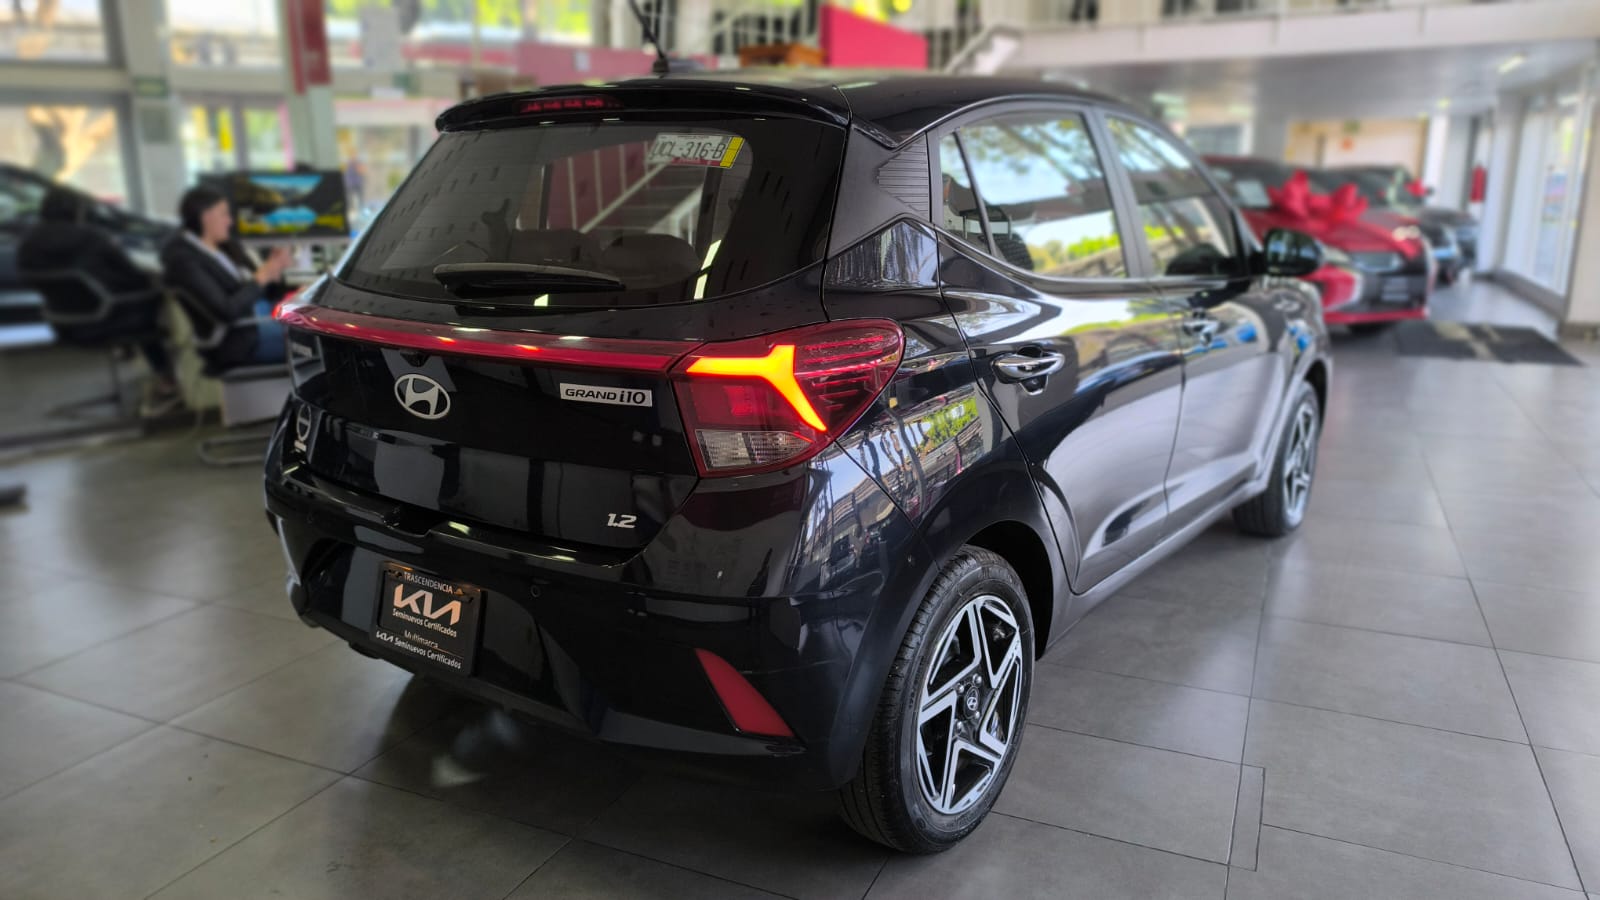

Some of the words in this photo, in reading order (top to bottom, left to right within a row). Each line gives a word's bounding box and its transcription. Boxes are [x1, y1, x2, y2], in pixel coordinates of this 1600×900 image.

[565, 388, 617, 400] GRAND
[619, 390, 646, 404] i10
[607, 513, 637, 529] 1.2
[404, 572, 453, 594] TRASCENDENCIA
[394, 584, 461, 625] KIA
[392, 608, 423, 626] Seminuevos
[423, 619, 457, 638] Certificados
[376, 630, 394, 643] KIA
[394, 637, 426, 656] Seminuevos
[427, 650, 461, 669] Certificados
